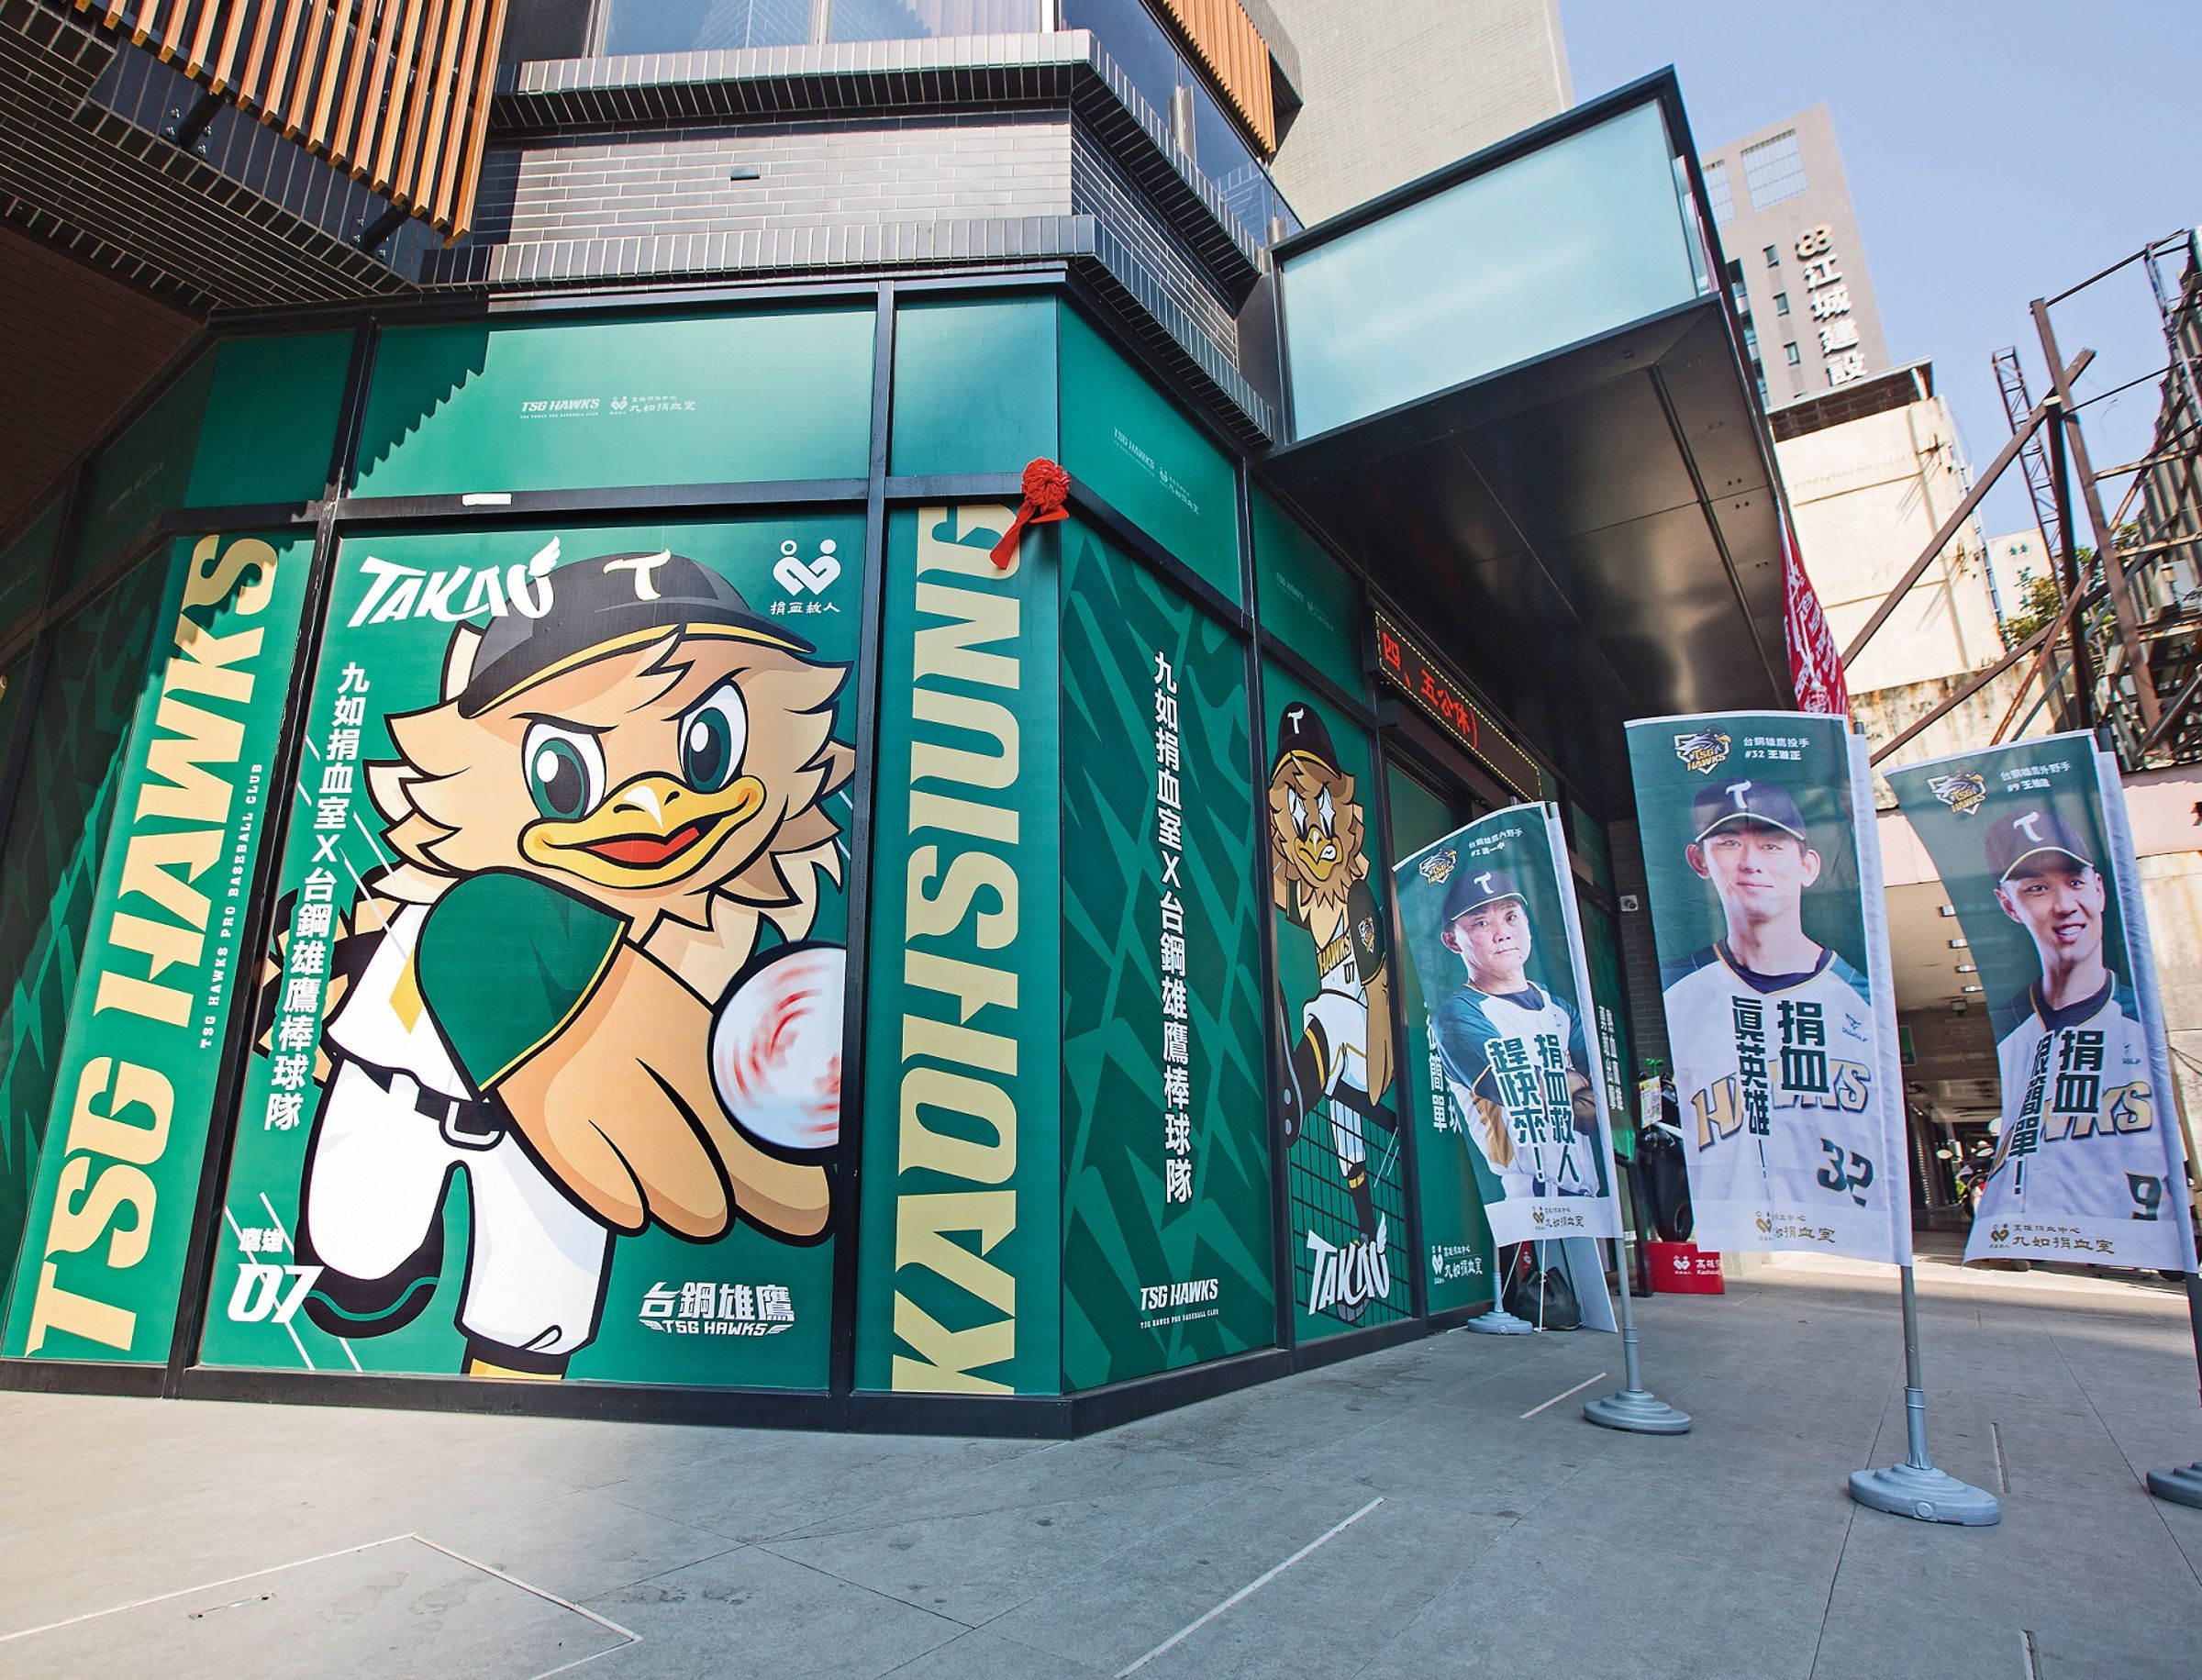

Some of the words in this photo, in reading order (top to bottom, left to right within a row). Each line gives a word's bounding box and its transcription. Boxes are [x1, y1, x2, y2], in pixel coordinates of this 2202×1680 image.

[1805, 253, 1868, 385] 江城建設
[549, 398, 600, 411] HAWKS
[770, 601, 841, 616] 捐血救人
[1745, 750, 1765, 759] #32
[94, 534, 277, 1028] HAWKS
[245, 763, 262, 804] CLUB
[228, 812, 253, 896] BASEBALL
[220, 906, 236, 938] PRO
[892, 503, 1019, 1395] KAOHSIUNG
[1318, 929, 1351, 979] HAWKS
[207, 947, 228, 1006] HAWKS
[200, 1016, 216, 1048] TSG
[1777, 999, 1829, 1094] 捐血
[2052, 1029, 2105, 1113] 捐血
[1534, 1033, 1580, 1183] 捐血救人
[1817, 1137, 1874, 1207] 32
[2125, 1172, 2163, 1220] 9
[25, 1056, 175, 1357] TSG
[2012, 1236, 2115, 1254] 九如捐血室
[228, 1263, 325, 1323] 07
[639, 1282, 795, 1322] 台鋼雄鷹
[1140, 1285, 1168, 1311] TSG
[1170, 1279, 1218, 1307] HAWKS
[662, 1319, 699, 1333] TSG
[705, 1321, 768, 1337] HAWKS
